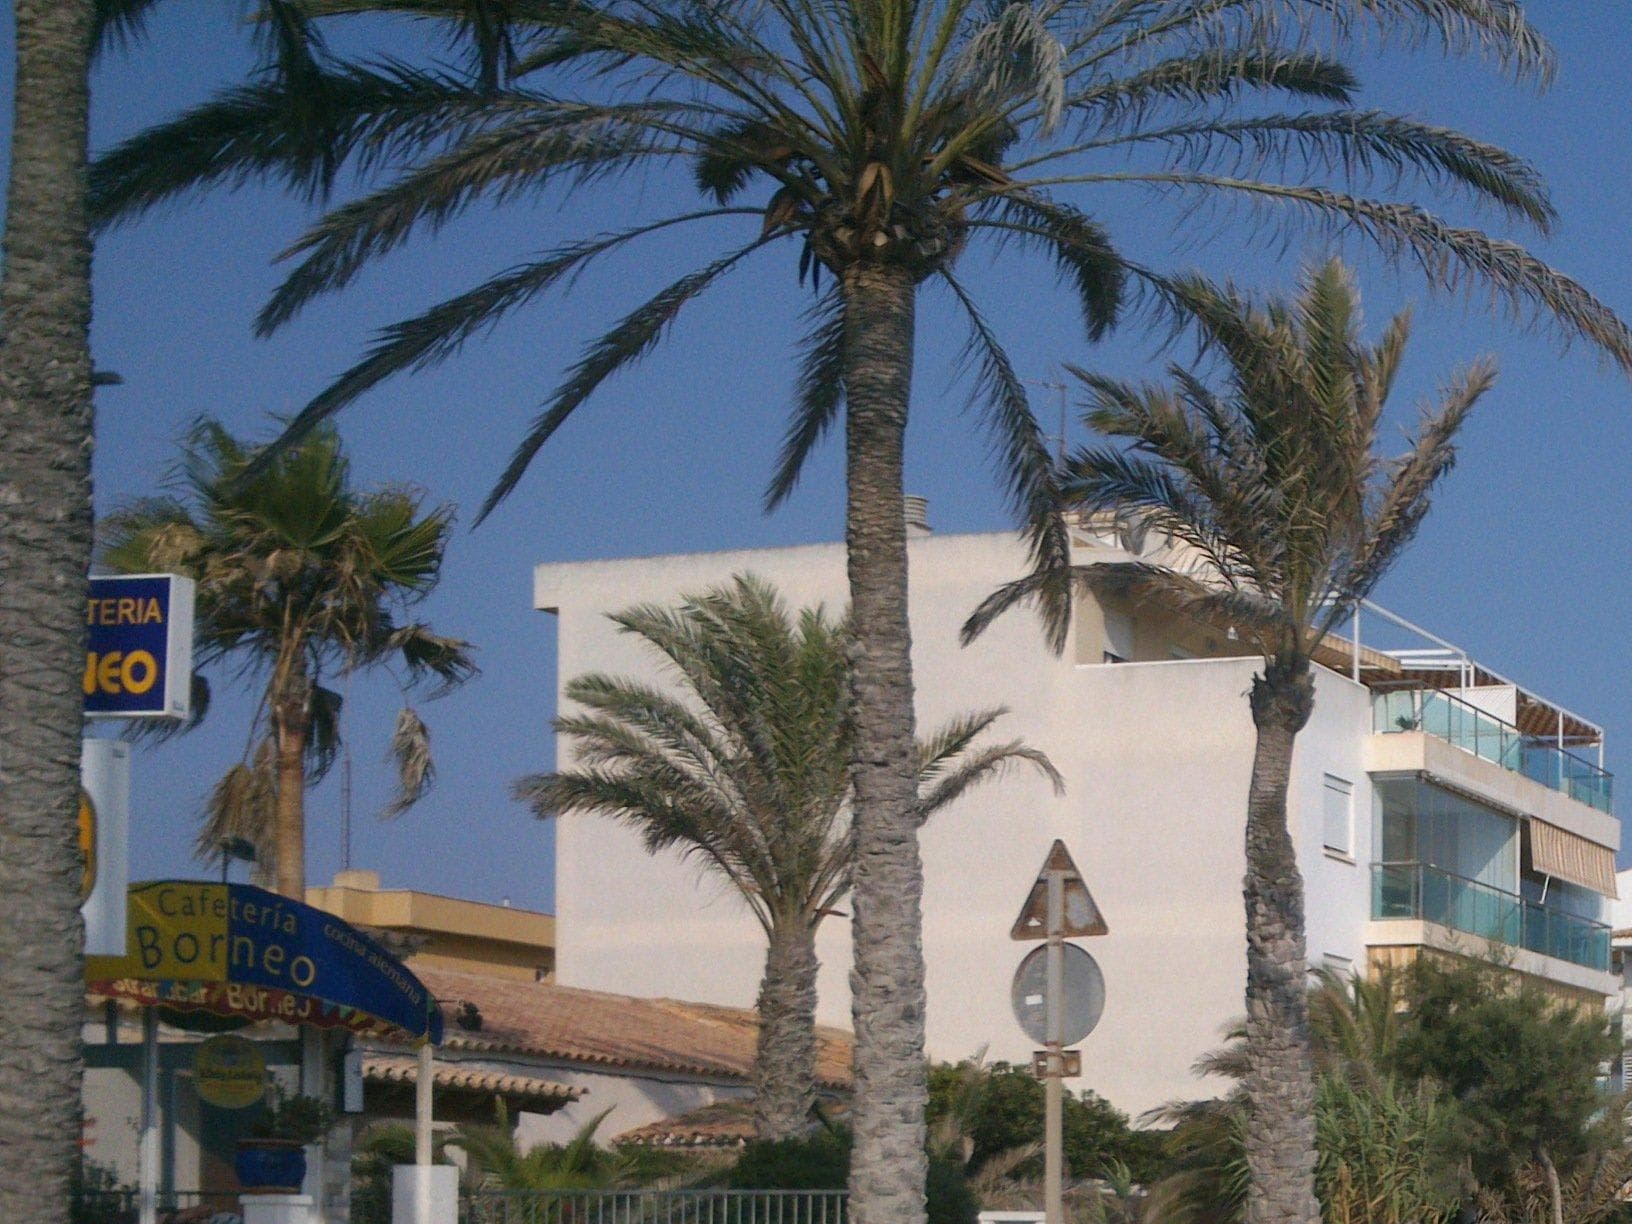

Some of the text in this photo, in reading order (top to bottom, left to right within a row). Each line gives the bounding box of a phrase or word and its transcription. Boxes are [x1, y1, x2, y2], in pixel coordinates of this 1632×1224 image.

[158, 888, 297, 935] Cafetería
[136, 925, 317, 988] Borneo
[323, 923, 421, 1008] cocina alemana
